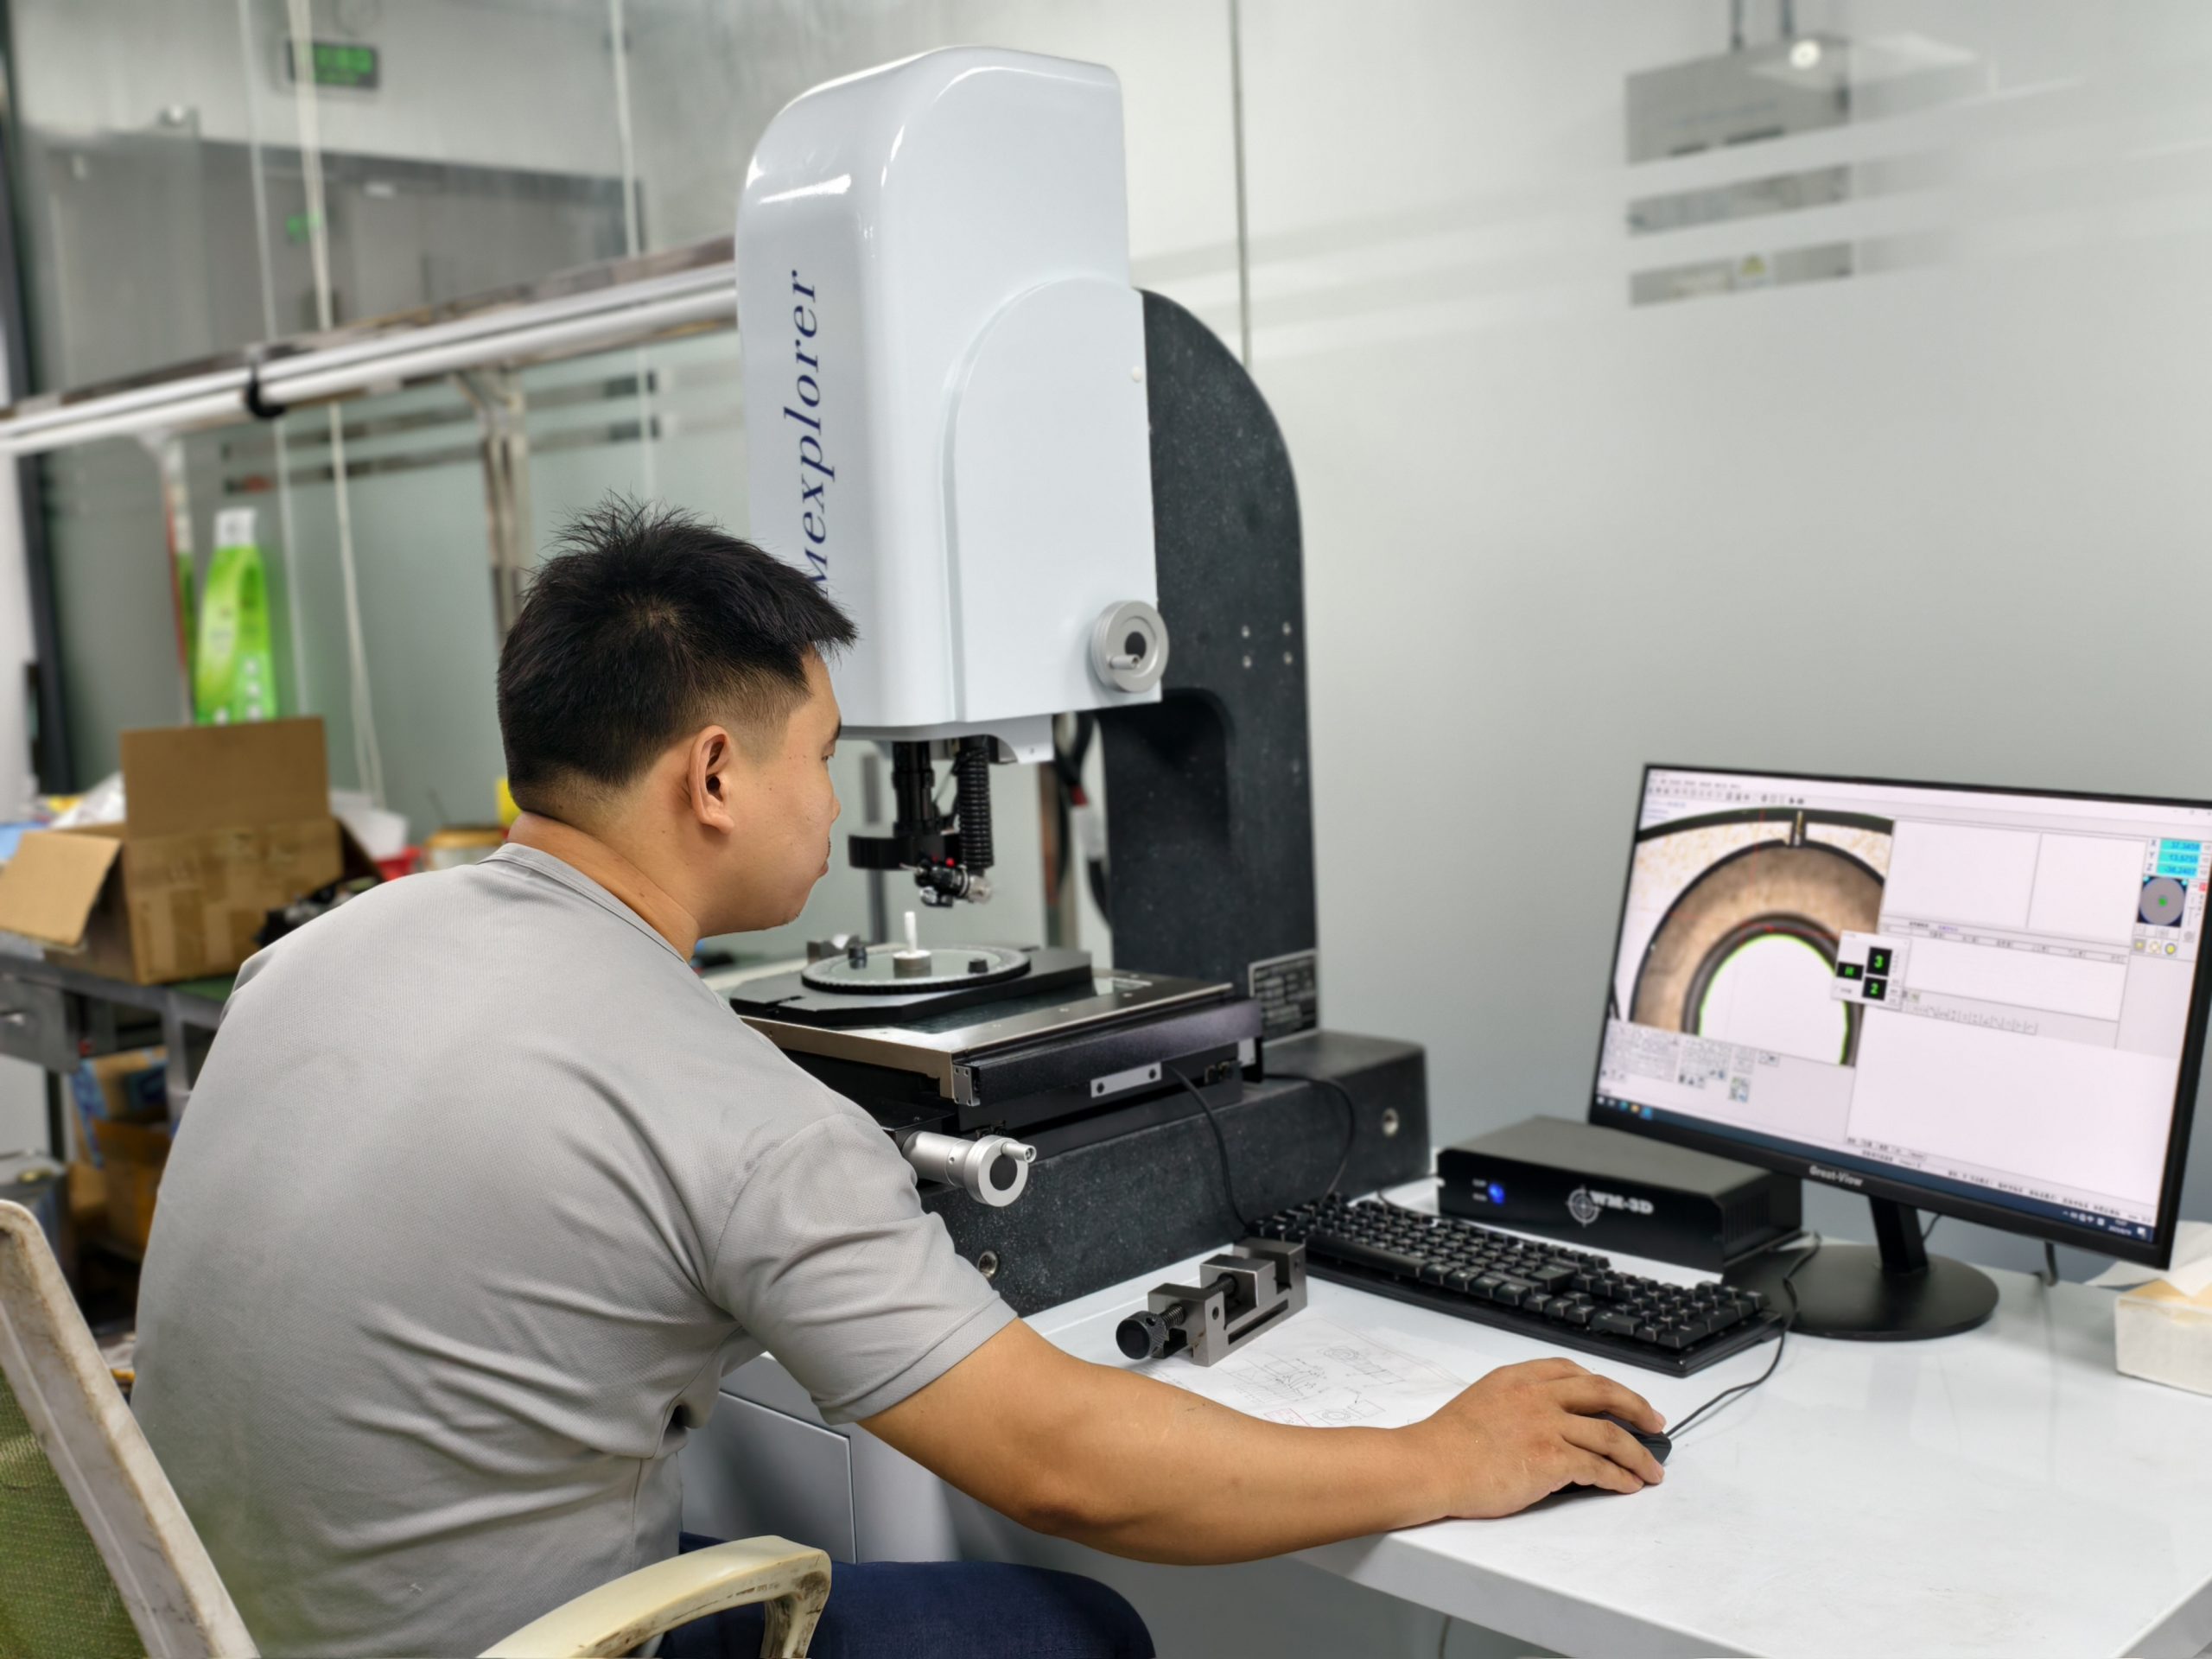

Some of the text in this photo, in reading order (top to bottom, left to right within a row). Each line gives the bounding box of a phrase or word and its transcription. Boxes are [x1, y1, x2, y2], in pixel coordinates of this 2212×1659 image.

[1874, 954, 1884, 969] 3
[1870, 982, 1879, 995] 2
[1808, 1165, 1865, 1187] Great-View
[1589, 1190, 1655, 1215] WM-3D
